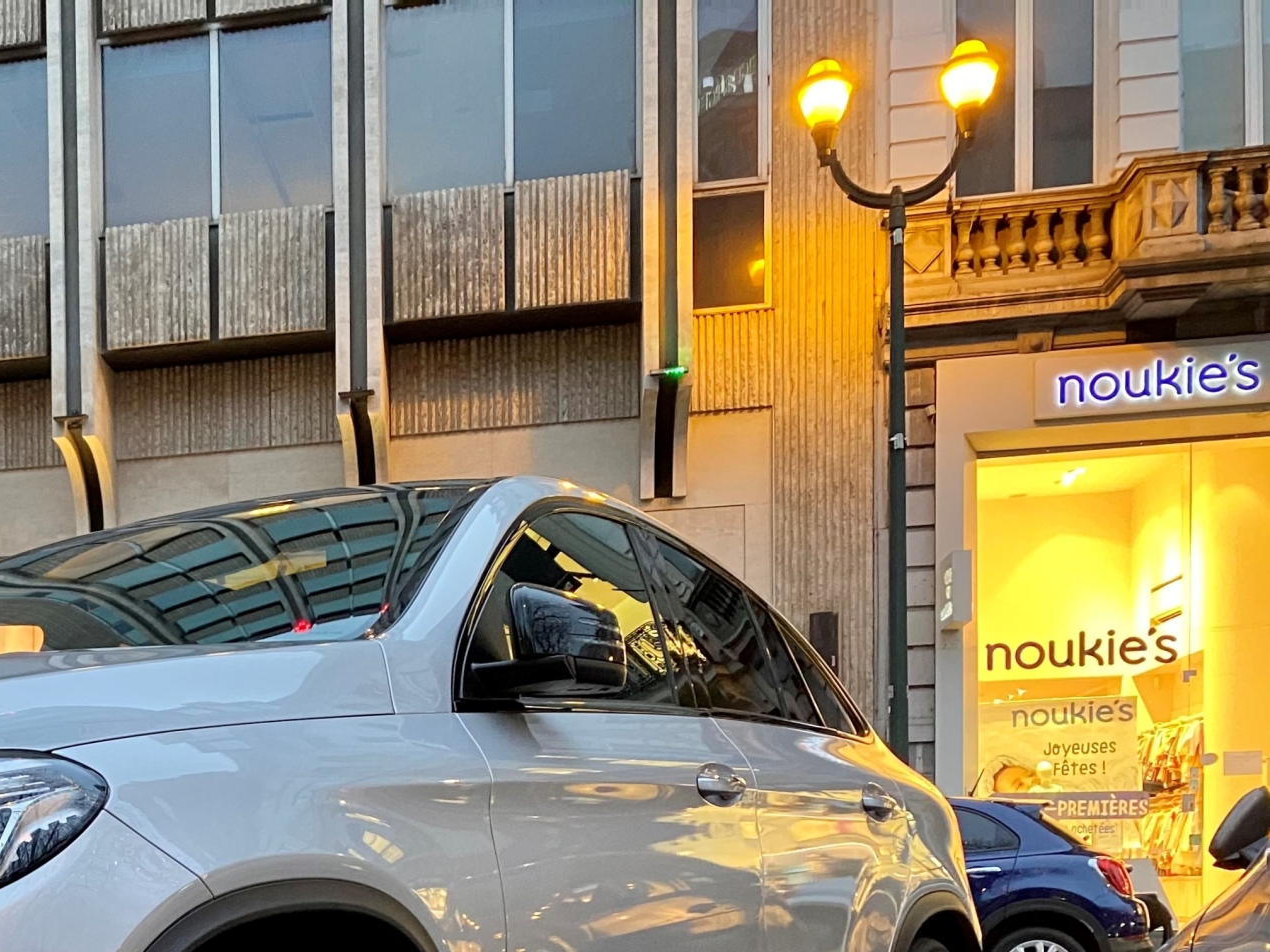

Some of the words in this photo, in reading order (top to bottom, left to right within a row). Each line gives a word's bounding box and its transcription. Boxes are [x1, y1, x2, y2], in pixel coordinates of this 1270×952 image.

[1058, 353, 1261, 404] noukie's
[985, 628, 1178, 671] noukie's
[1011, 700, 1134, 728] noukie's
[1043, 741, 1117, 758] Joyeuses
[1053, 759, 1097, 776] Fêtes
